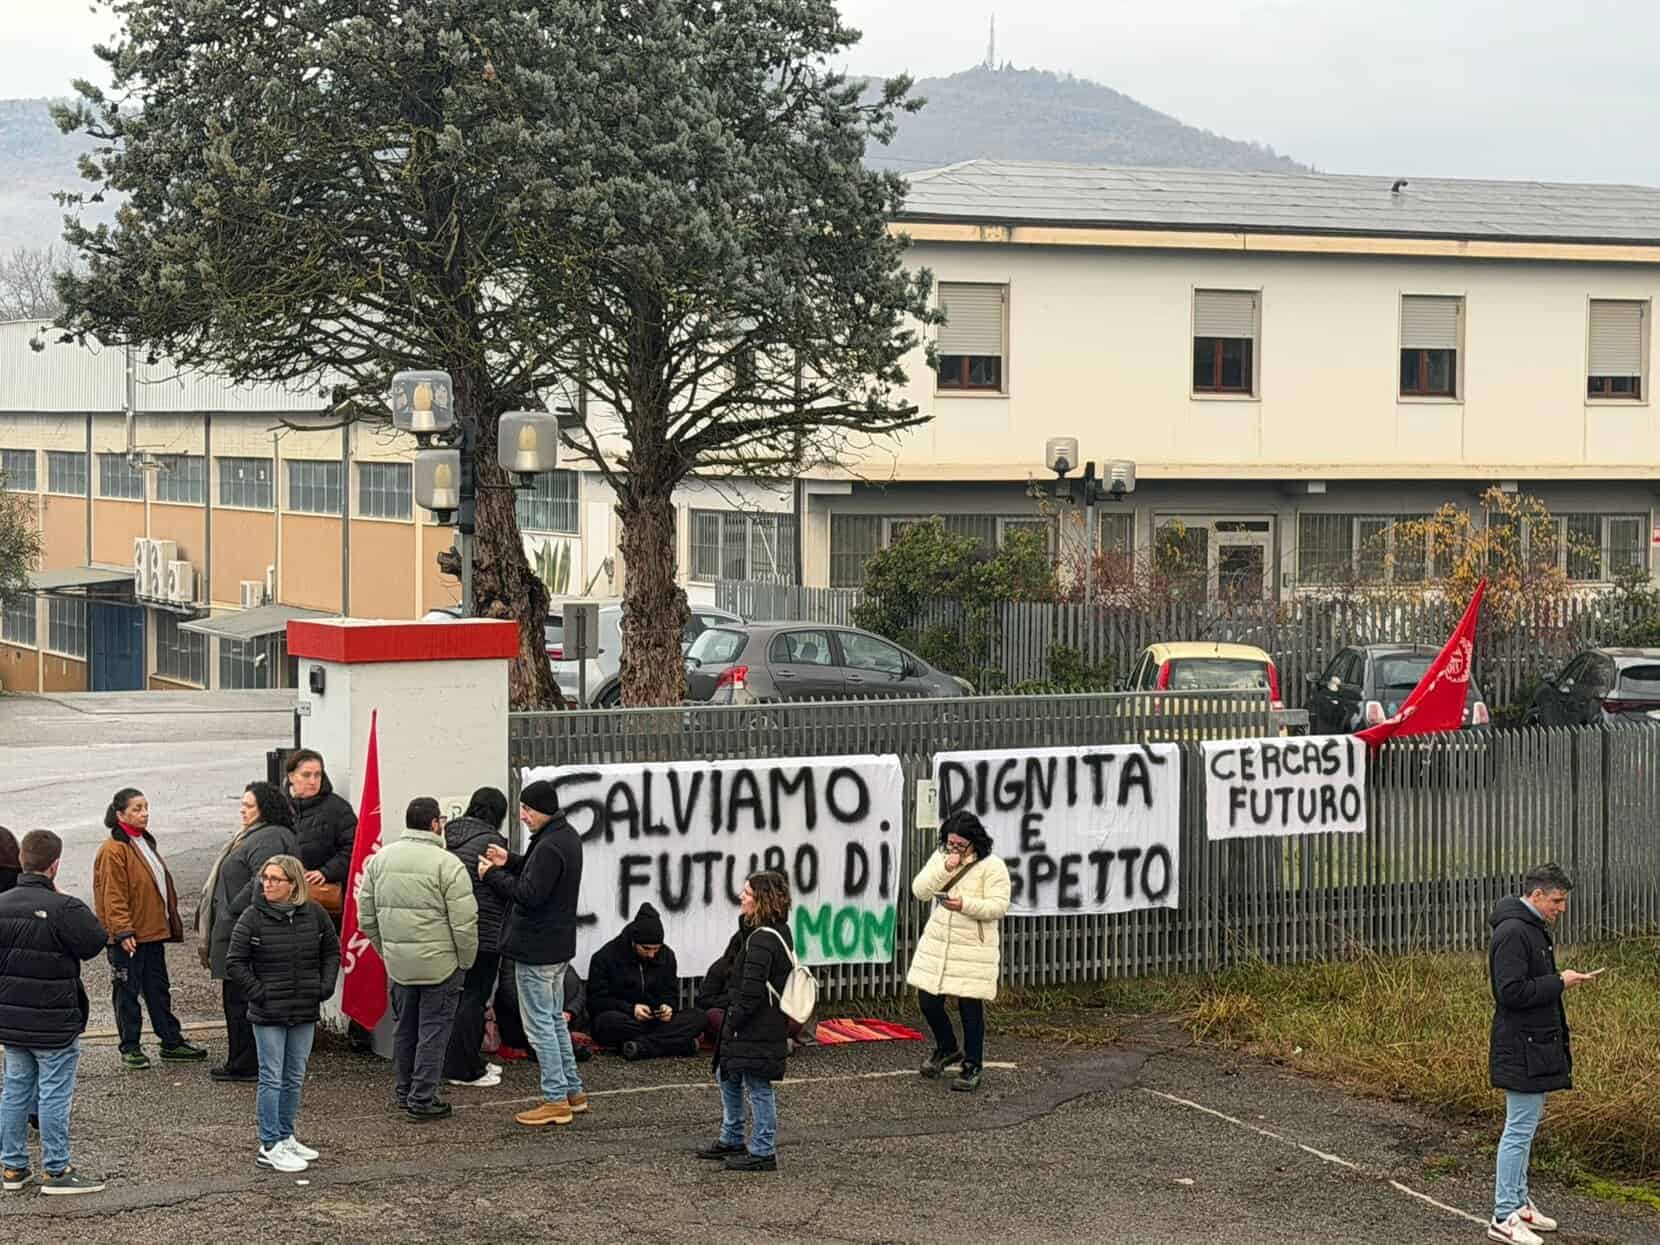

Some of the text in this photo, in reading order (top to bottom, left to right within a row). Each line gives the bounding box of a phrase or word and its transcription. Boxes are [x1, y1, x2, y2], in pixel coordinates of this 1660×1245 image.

[938, 743, 1166, 818] DIGNITÀ
[1210, 738, 1357, 781] CERCASI
[552, 766, 871, 843] SALVIAMO
[1229, 783, 1361, 827] FUTURO
[1020, 812, 1047, 852] E
[795, 903, 896, 960] MOM
